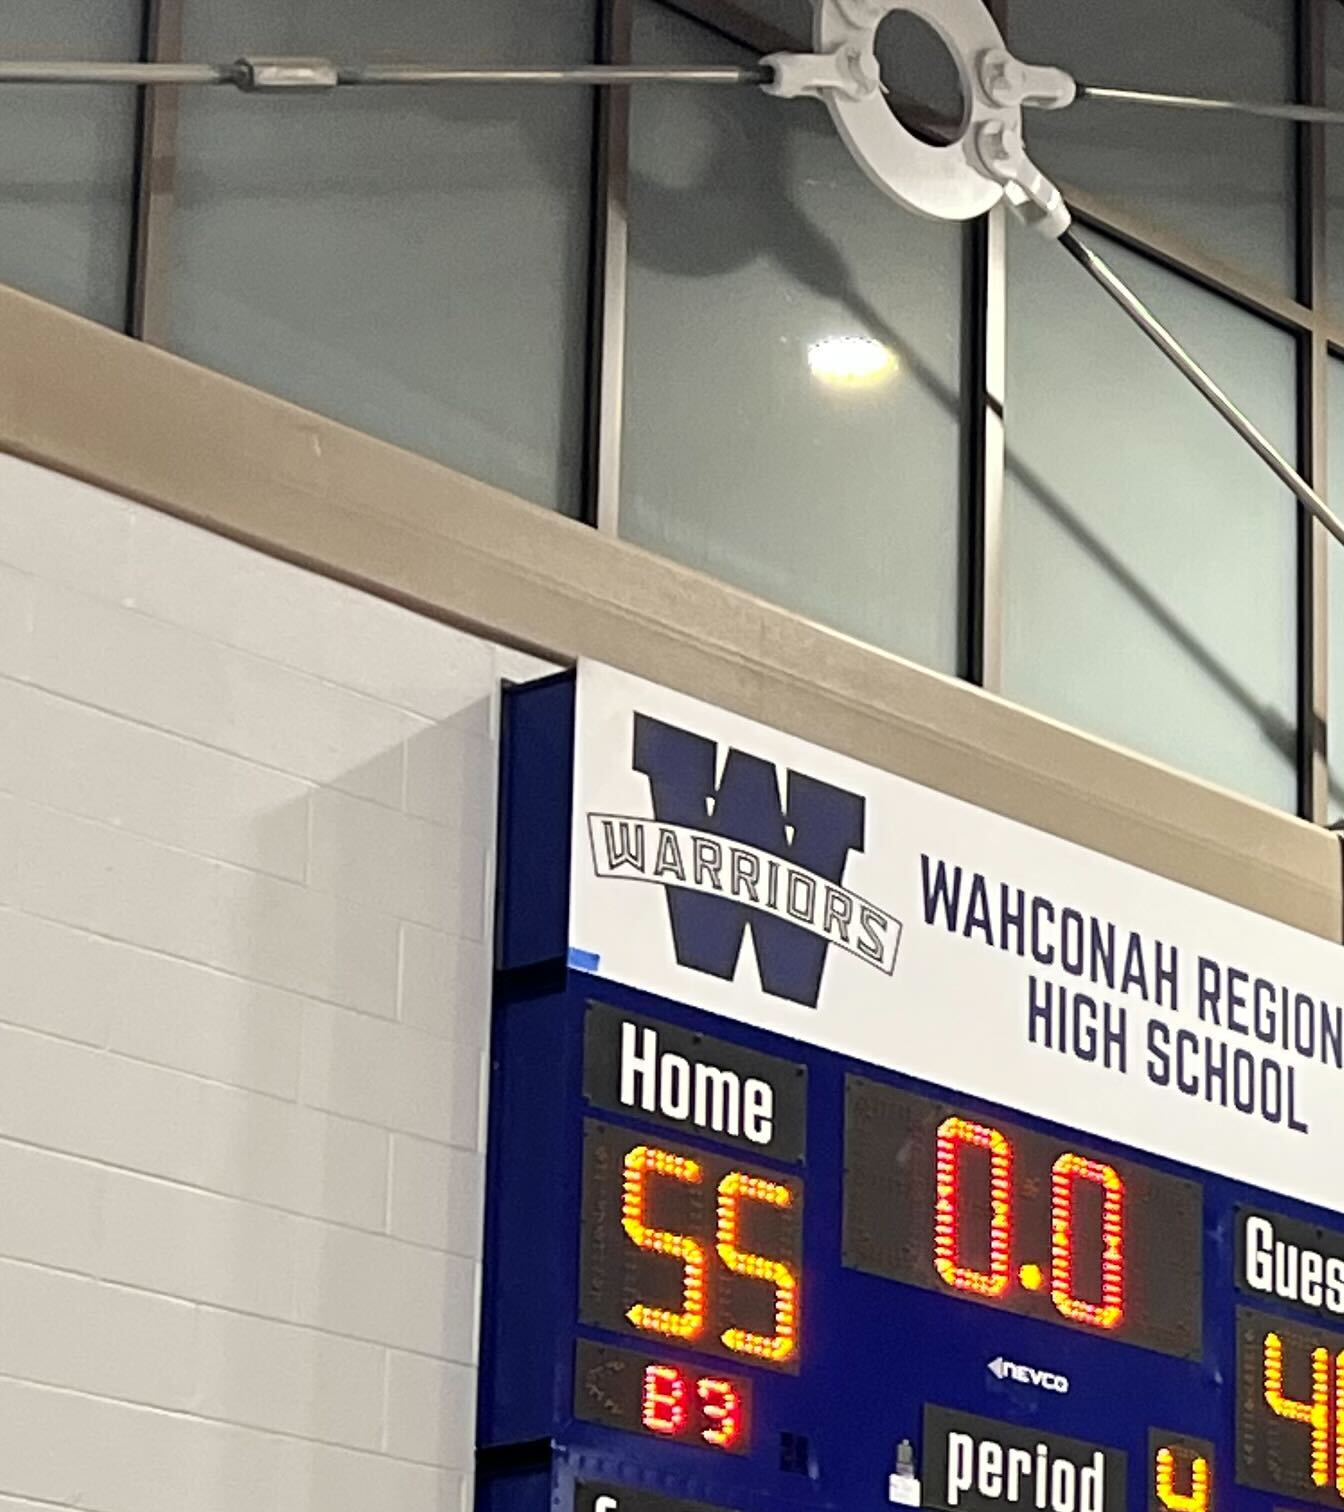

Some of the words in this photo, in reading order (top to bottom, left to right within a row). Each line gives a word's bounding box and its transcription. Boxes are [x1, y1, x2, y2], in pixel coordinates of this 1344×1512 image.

[602, 820, 888, 964] WARRIORS
[920, 854, 1180, 1012] WAHCONAH
[620, 1021, 773, 1145] Home
[1028, 976, 1128, 1075] HIGH
[1147, 1020, 1310, 1135] SCHOOL
[622, 1146, 797, 1361] 55
[934, 1115, 1125, 1329] 0.0
